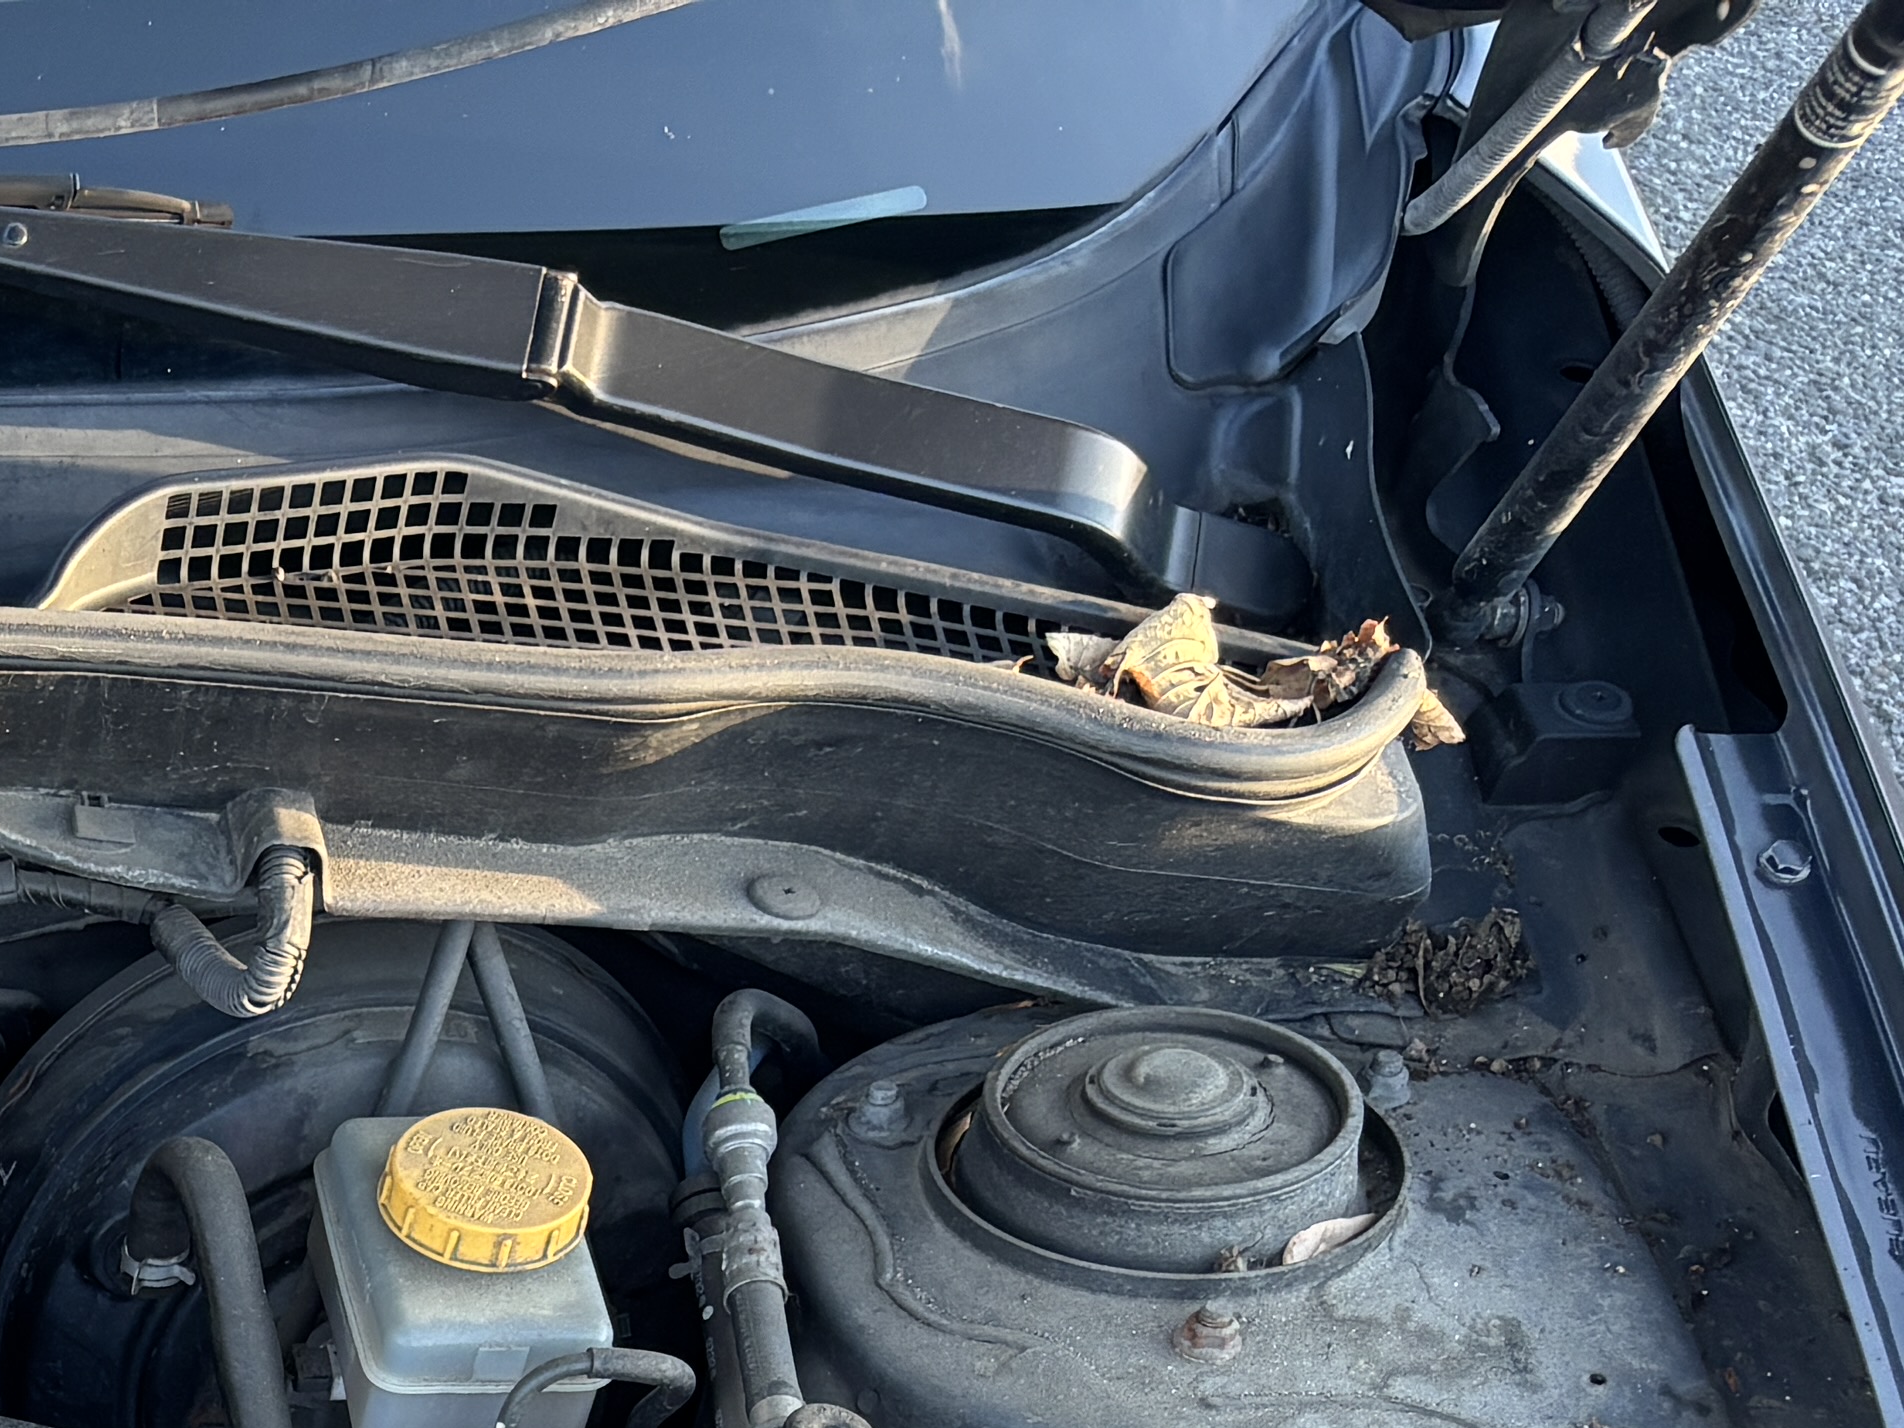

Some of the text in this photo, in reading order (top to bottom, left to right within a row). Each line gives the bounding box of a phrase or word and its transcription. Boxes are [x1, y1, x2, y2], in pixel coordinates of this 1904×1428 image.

[417, 1179, 441, 1194] CAP
[434, 1195, 492, 1223] WARNING
[486, 1189, 528, 1210] BEFORE
[486, 1200, 522, 1222] CLEAN
